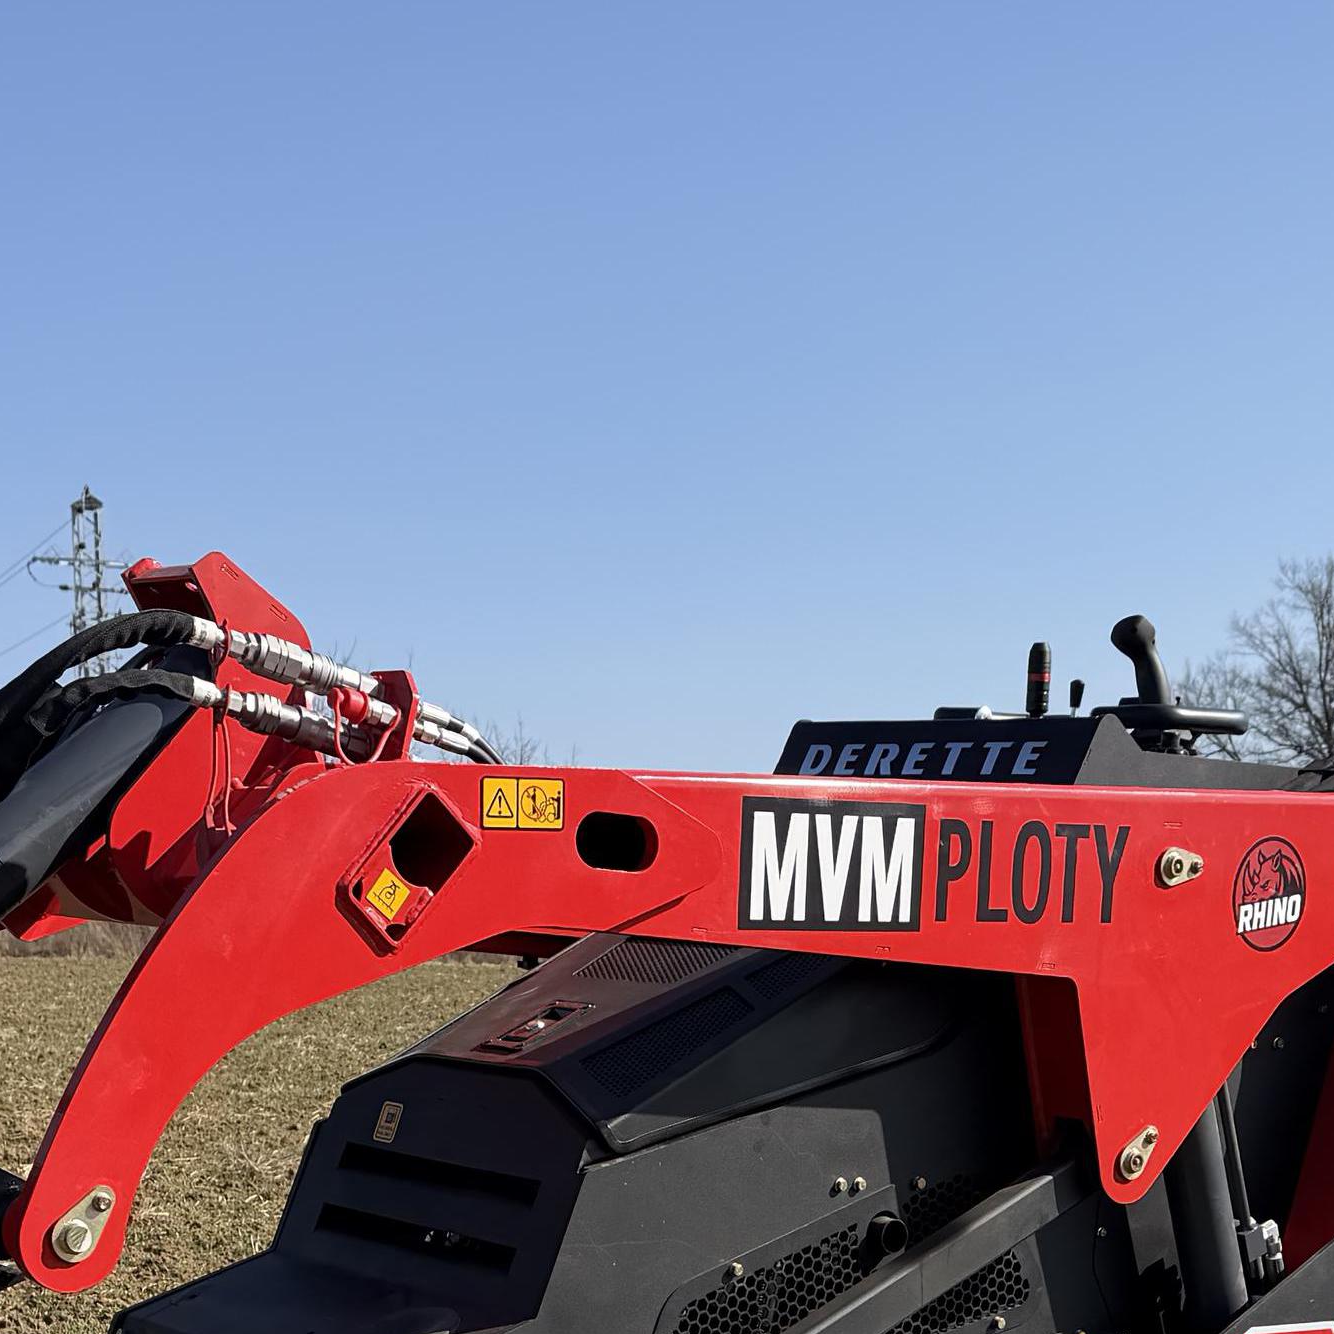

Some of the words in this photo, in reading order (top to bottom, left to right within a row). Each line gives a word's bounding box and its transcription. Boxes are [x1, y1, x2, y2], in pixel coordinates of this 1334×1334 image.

[798, 740, 1049, 776] DERETTE
[748, 810, 916, 923] MVM
[934, 818, 1132, 925] PLOTY
[1237, 893, 1303, 934] RHINO
